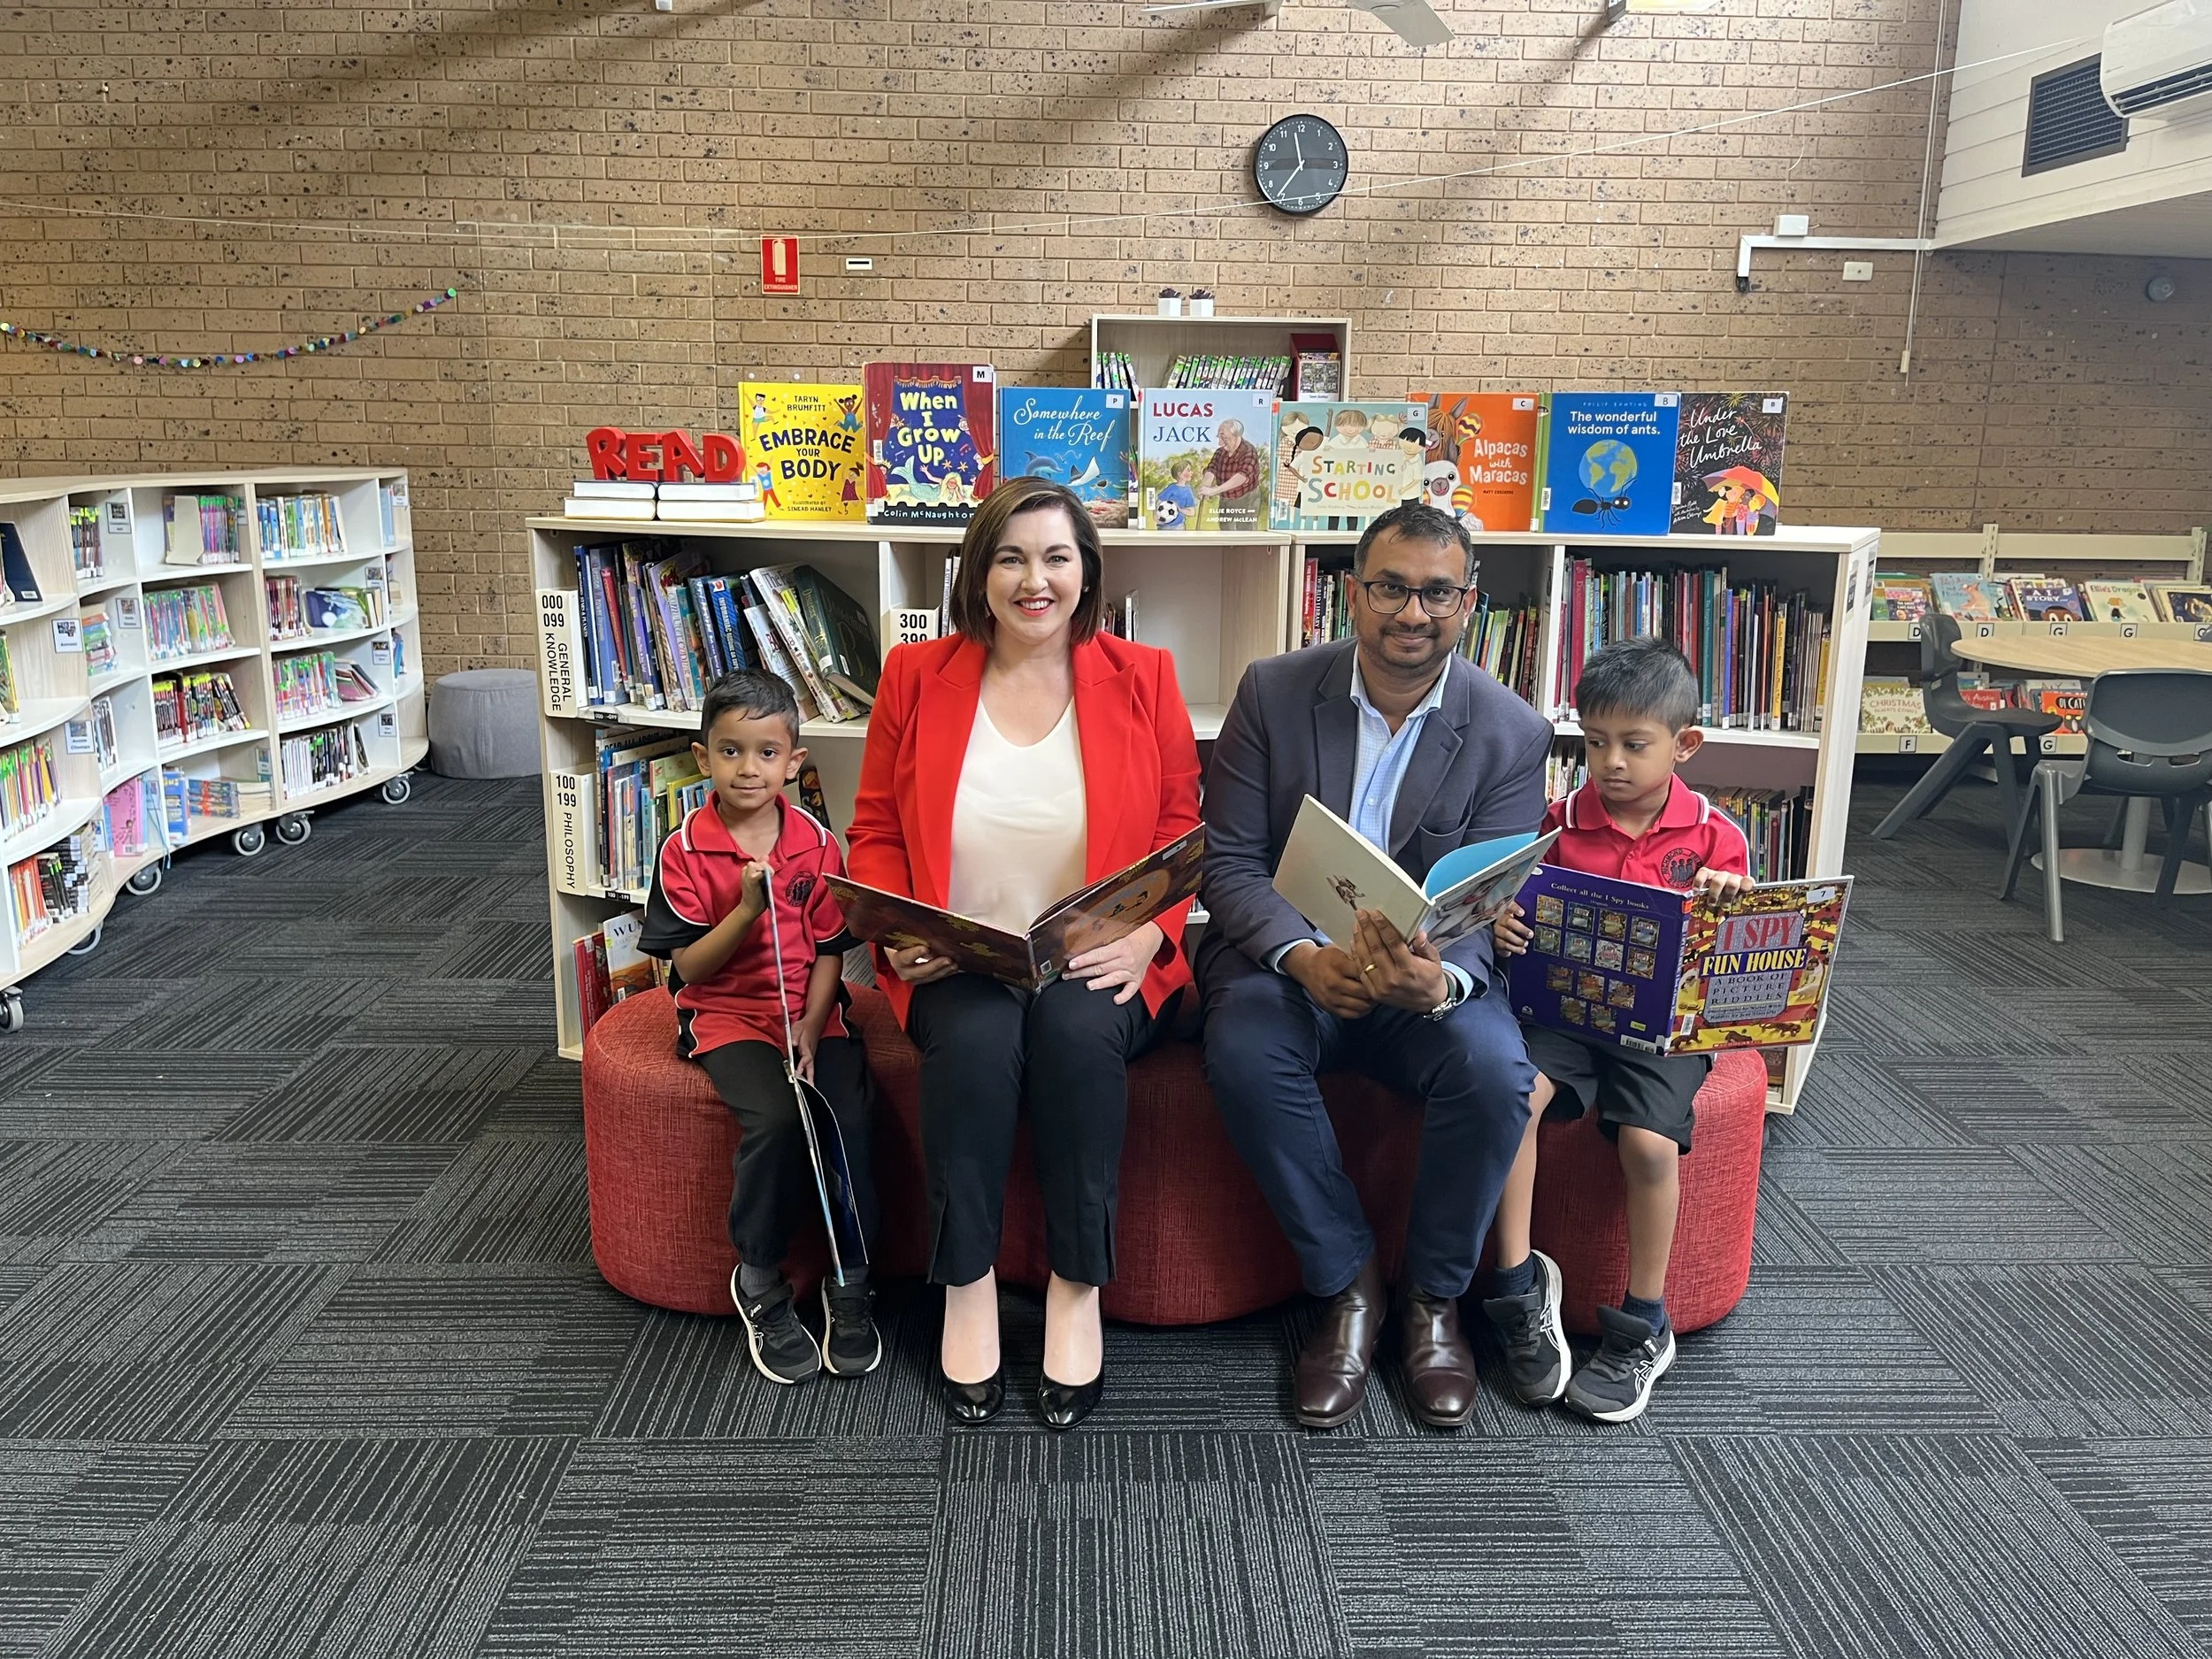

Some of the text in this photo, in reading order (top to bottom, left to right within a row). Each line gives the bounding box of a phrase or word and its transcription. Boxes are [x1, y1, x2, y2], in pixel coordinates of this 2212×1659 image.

[1298, 124, 1306, 133] 12
[1268, 143, 1276, 152] 10
[1263, 162, 1269, 170] 9
[1333, 161, 1338, 169] 3
[900, 391, 958, 411] When
[1663, 397, 1668, 406] B
[1014, 395, 1102, 425] Somewhere
[1153, 403, 1214, 418] LUCAS
[1570, 411, 1657, 422] The wonderful
[1690, 407, 1737, 428] Under
[921, 411, 933, 427] I
[1153, 426, 1212, 442] JACK
[1568, 423, 1661, 434] wisdom of ants.
[1679, 425, 1738, 447] the Love
[759, 428, 856, 454] EMBRACE
[897, 427, 961, 447] Grow
[1034, 420, 1115, 453] in the Reef
[586, 426, 746, 483] READ
[796, 448, 820, 457] YOUR
[918, 444, 945, 466] Up
[1474, 439, 1528, 460] Alpacas
[1690, 436, 1763, 469] Umbrella
[780, 458, 841, 481] BODY
[1312, 456, 1395, 476] STARTING
[1489, 457, 1513, 469] with
[1469, 465, 1528, 485] Maracas
[1308, 478, 1398, 503] SCHOOL
[883, 510, 908, 518] Colin
[2112, 586, 2143, 595] Dragon
[542, 595, 563, 609] 000
[543, 613, 565, 627] 099
[900, 614, 927, 629] 300
[1913, 627, 1920, 637] D
[1981, 627, 1989, 637] D
[2053, 627, 2063, 636] G
[2124, 628, 2133, 637] G
[545, 633, 561, 711] KNOWLEDGE
[558, 643, 572, 702] GENERAL
[1870, 700, 1921, 709] CHRISTMAS
[2058, 697, 2085, 710] OI CAT
[1905, 740, 1911, 749] F
[2043, 740, 2053, 750] G
[556, 775, 576, 790] 100
[557, 793, 576, 807] 199
[563, 812, 576, 889] PHILOSOPHY
[1551, 883, 1577, 894] Collect
[1611, 896, 1624, 905] Spy
[1627, 899, 1649, 909] books
[1723, 915, 1800, 952] I SPY
[1701, 948, 1807, 976] FUN HOUSE
[1728, 974, 1765, 983] BOOK
[1713, 982, 1786, 995] PICTURE
[1710, 993, 1783, 1005] RIDDLES
